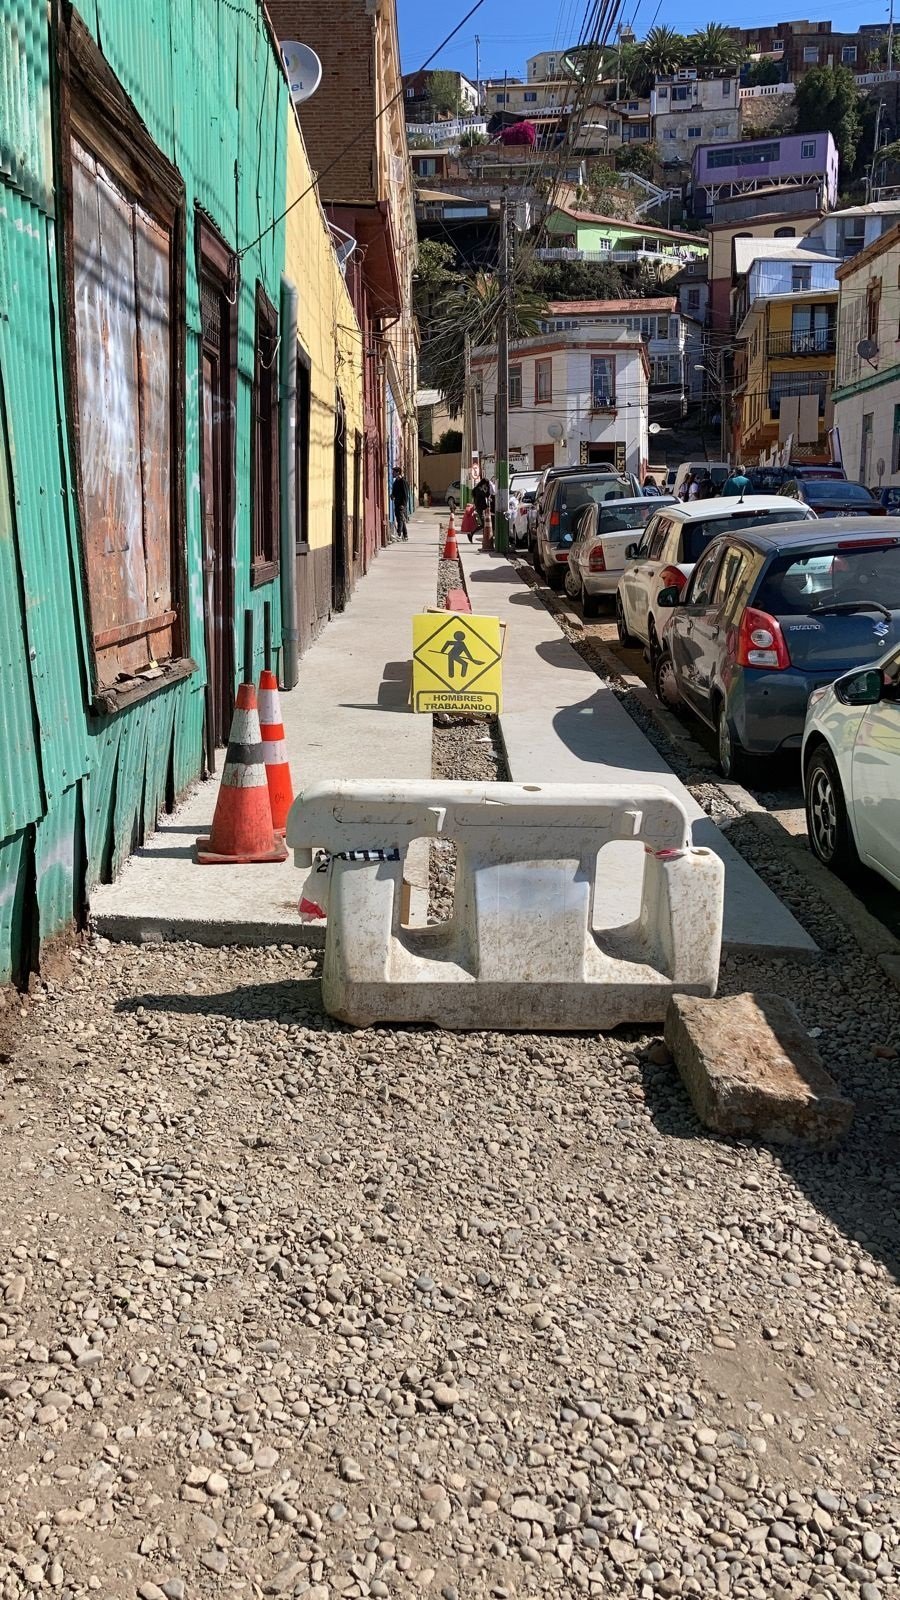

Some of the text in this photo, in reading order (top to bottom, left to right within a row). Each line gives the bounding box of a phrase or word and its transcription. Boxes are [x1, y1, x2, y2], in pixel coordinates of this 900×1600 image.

[290, 81, 304, 92] el
[580, 441, 588, 465] VULCAN
[433, 694, 483, 703] HOMBRES
[424, 703, 493, 711] TRABAJANDO
